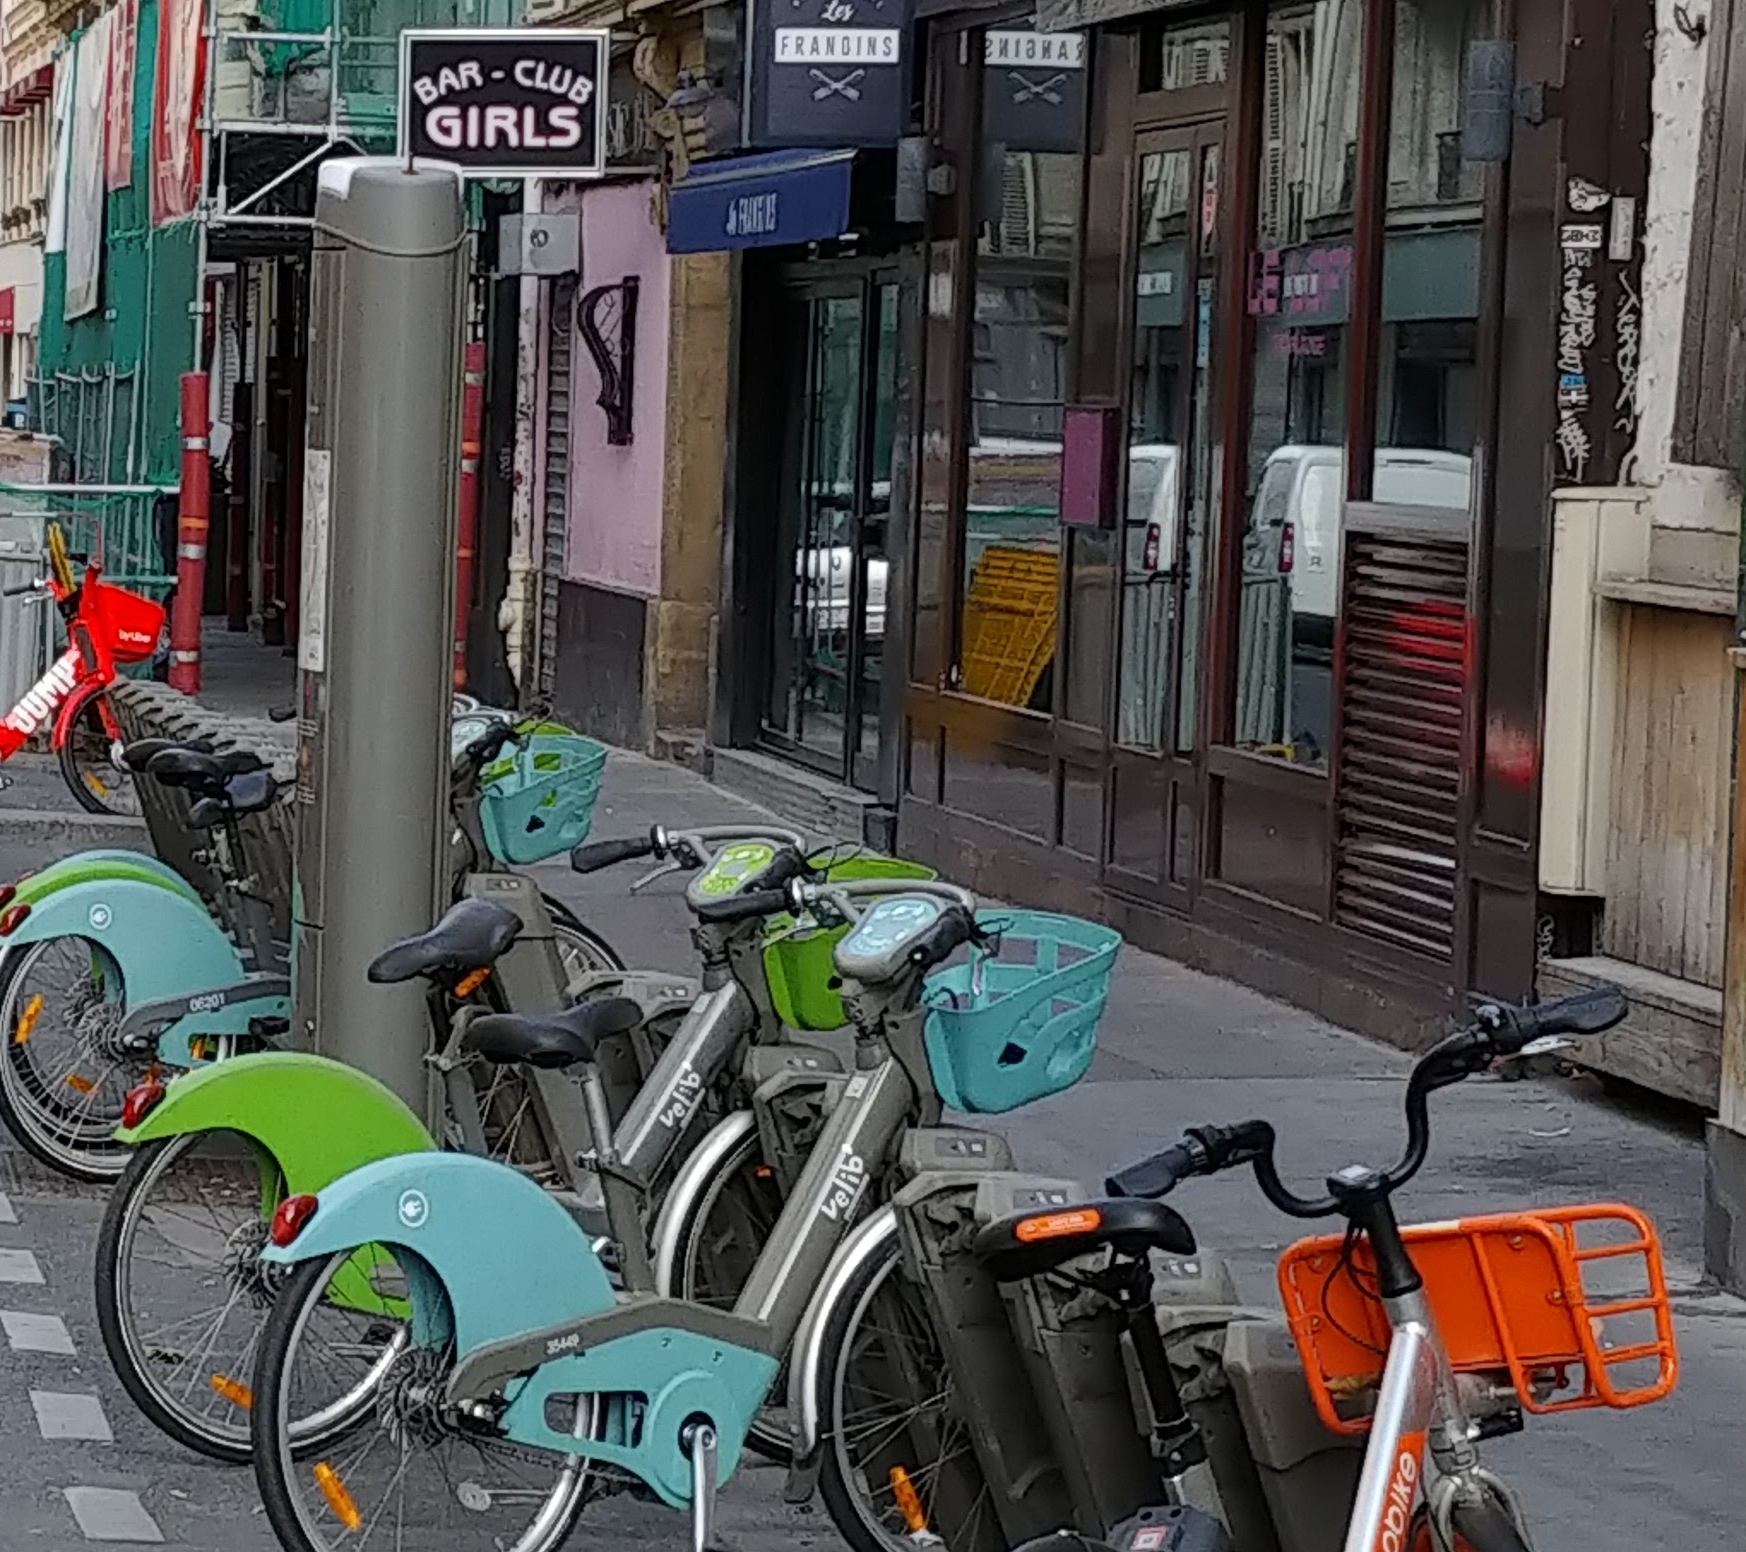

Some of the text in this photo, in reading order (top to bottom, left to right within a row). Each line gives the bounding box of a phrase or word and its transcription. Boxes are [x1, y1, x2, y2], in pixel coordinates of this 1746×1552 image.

[414, 61, 484, 105] BAR
[515, 60, 593, 104] CLUB
[425, 105, 582, 148] GIRLS
[4, 647, 81, 734] JUMP
